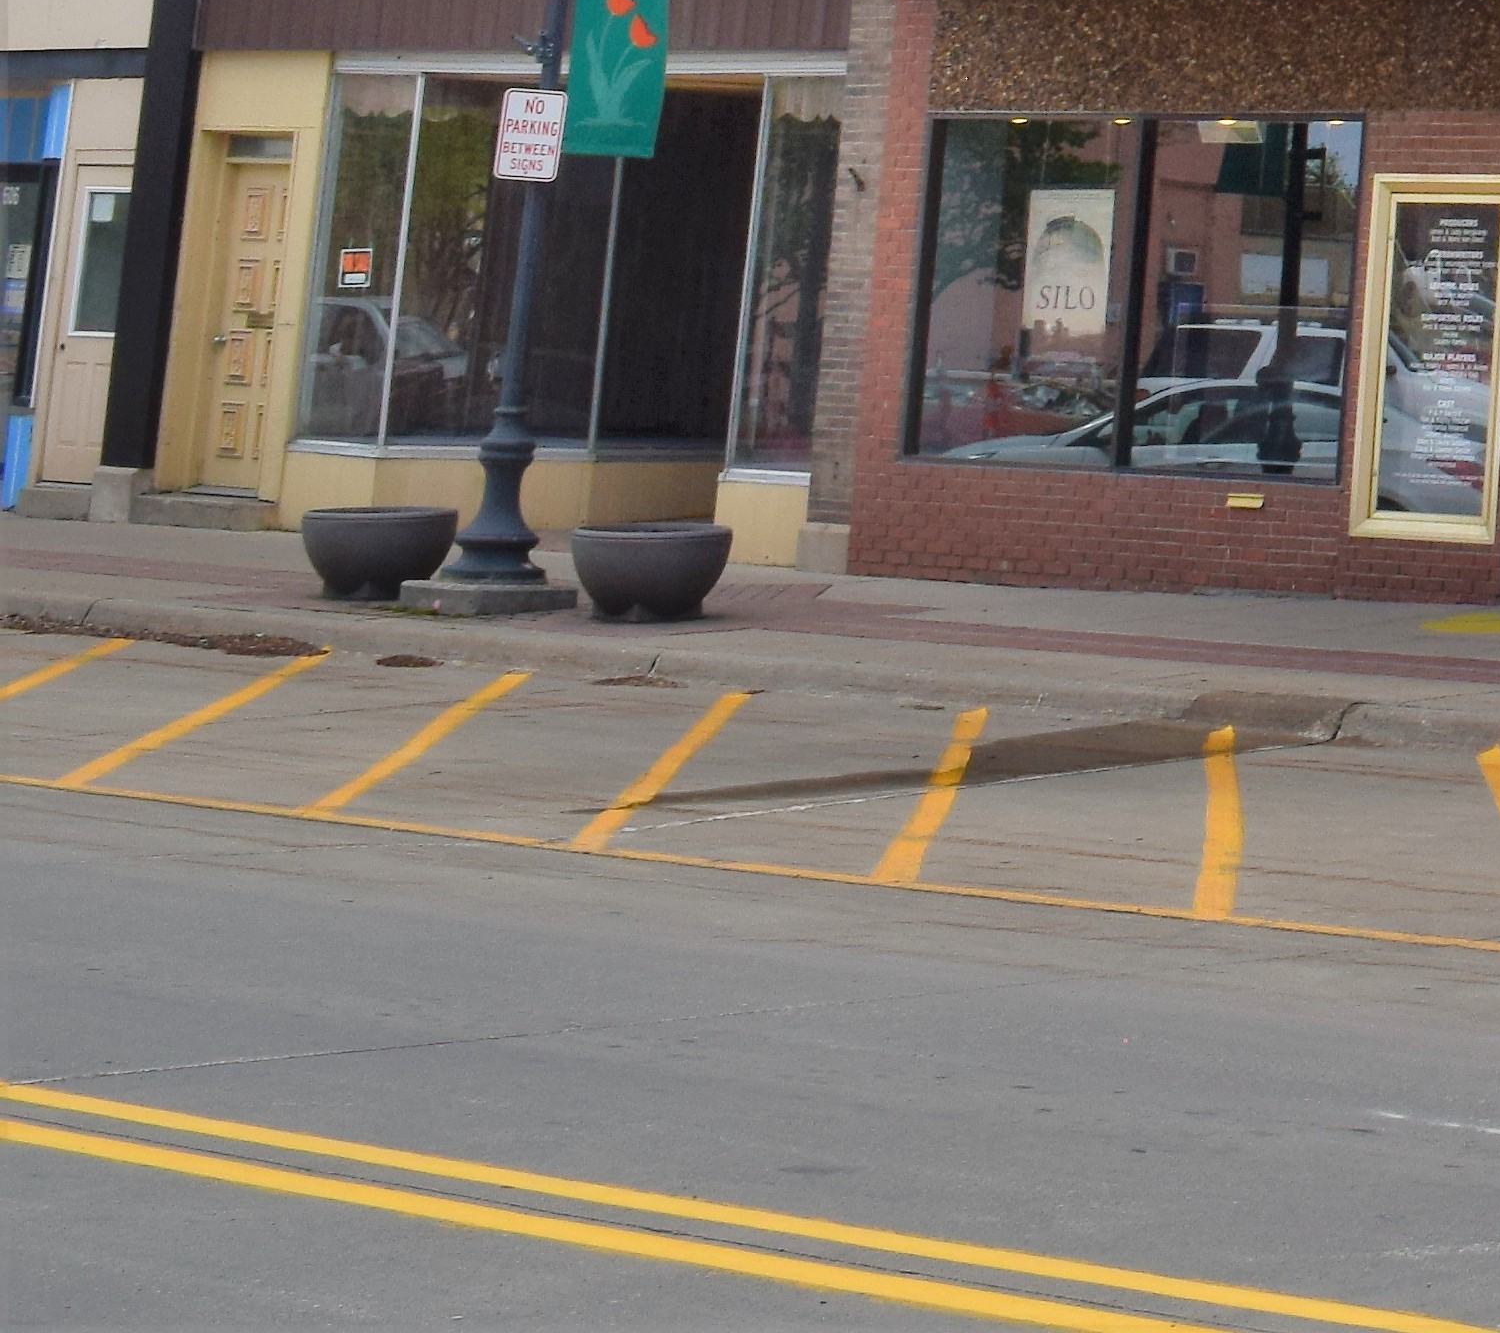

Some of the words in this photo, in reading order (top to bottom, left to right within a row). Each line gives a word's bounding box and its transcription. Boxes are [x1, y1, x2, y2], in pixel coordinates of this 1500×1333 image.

[524, 99, 545, 114] NO
[506, 118, 559, 136] PARKING
[502, 141, 556, 156] BETWEEN
[510, 157, 543, 171] SIGNS
[1036, 285, 1096, 310] SILO
